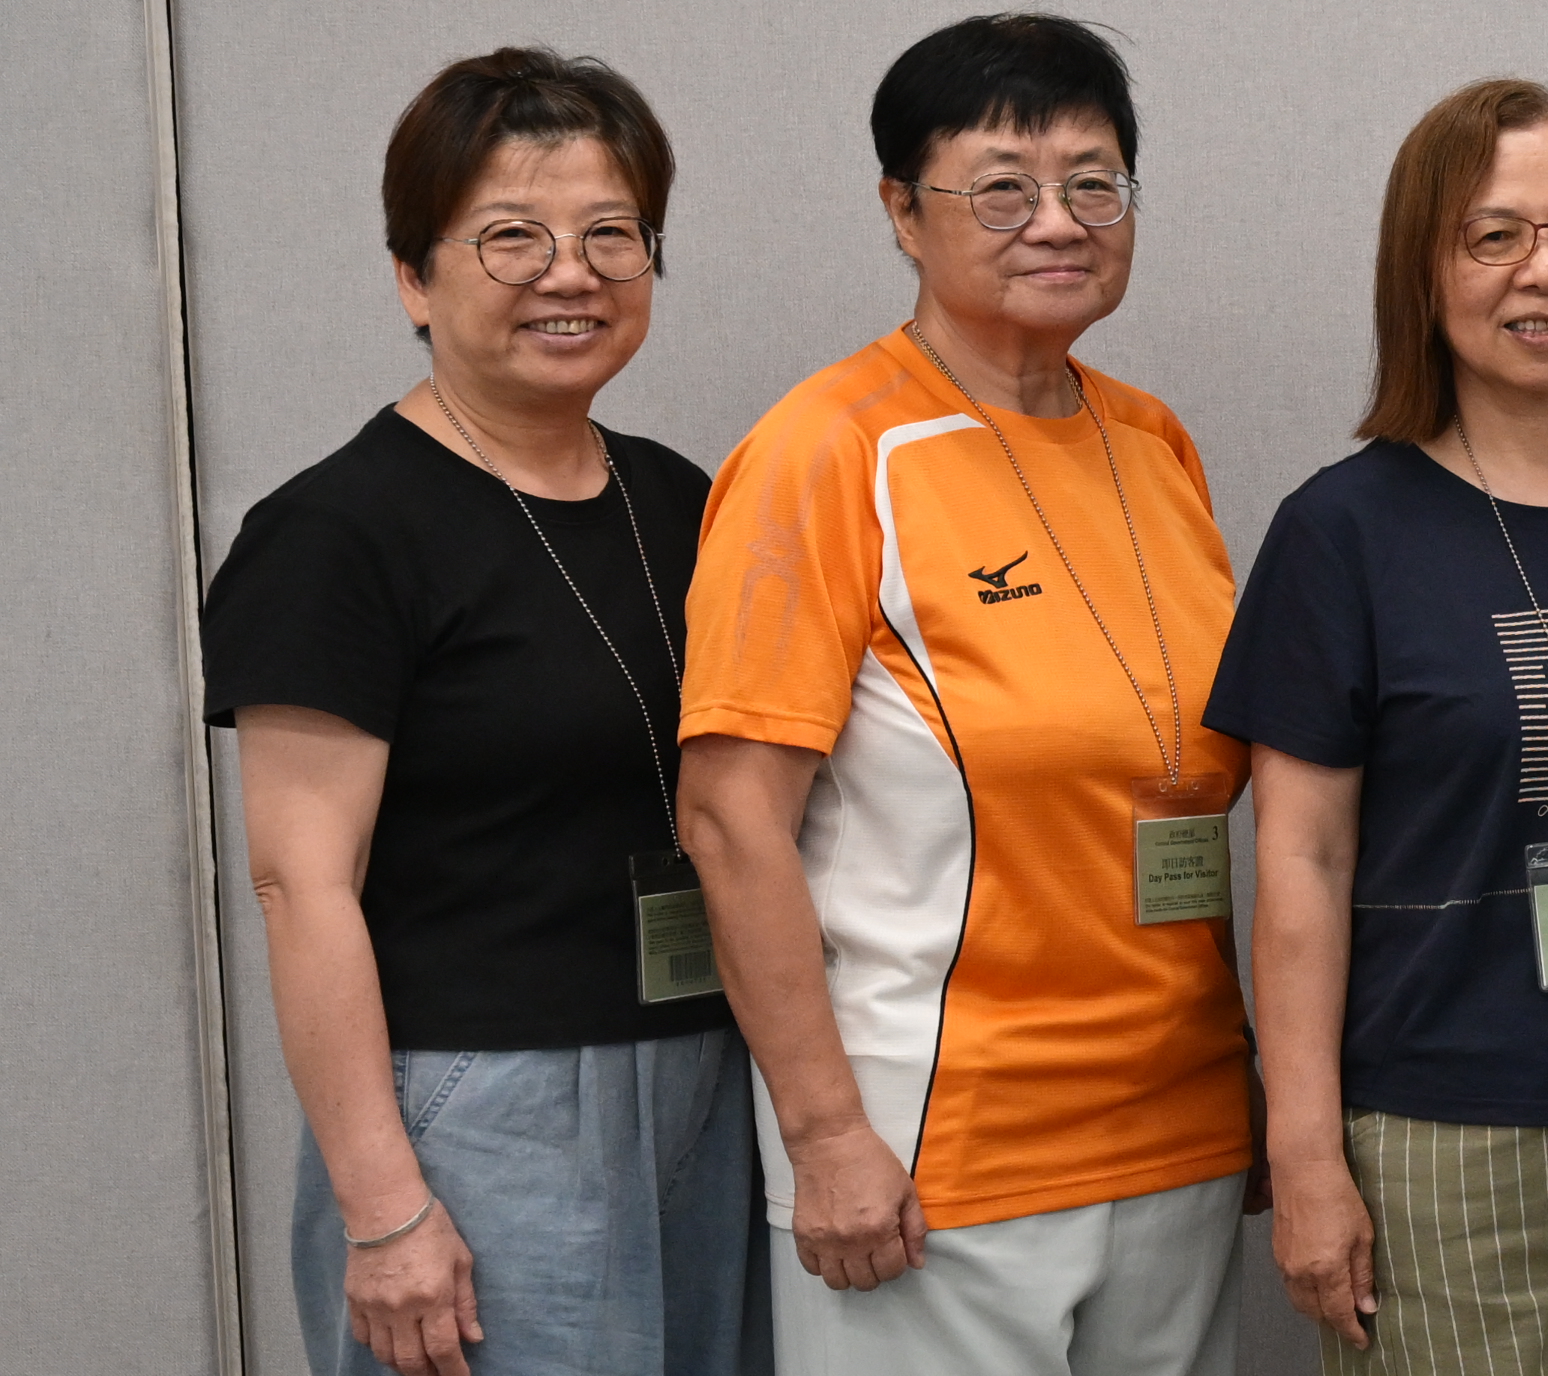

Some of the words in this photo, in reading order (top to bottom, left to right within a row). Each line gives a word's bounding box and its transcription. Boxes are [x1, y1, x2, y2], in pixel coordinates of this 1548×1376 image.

[978, 583, 1042, 605] MIZUNO
[1212, 826, 1218, 840] 3
[1148, 874, 1162, 883] Day
[1164, 873, 1181, 881] Pass
[1184, 871, 1193, 879] for
[1195, 869, 1218, 878] Visitor
